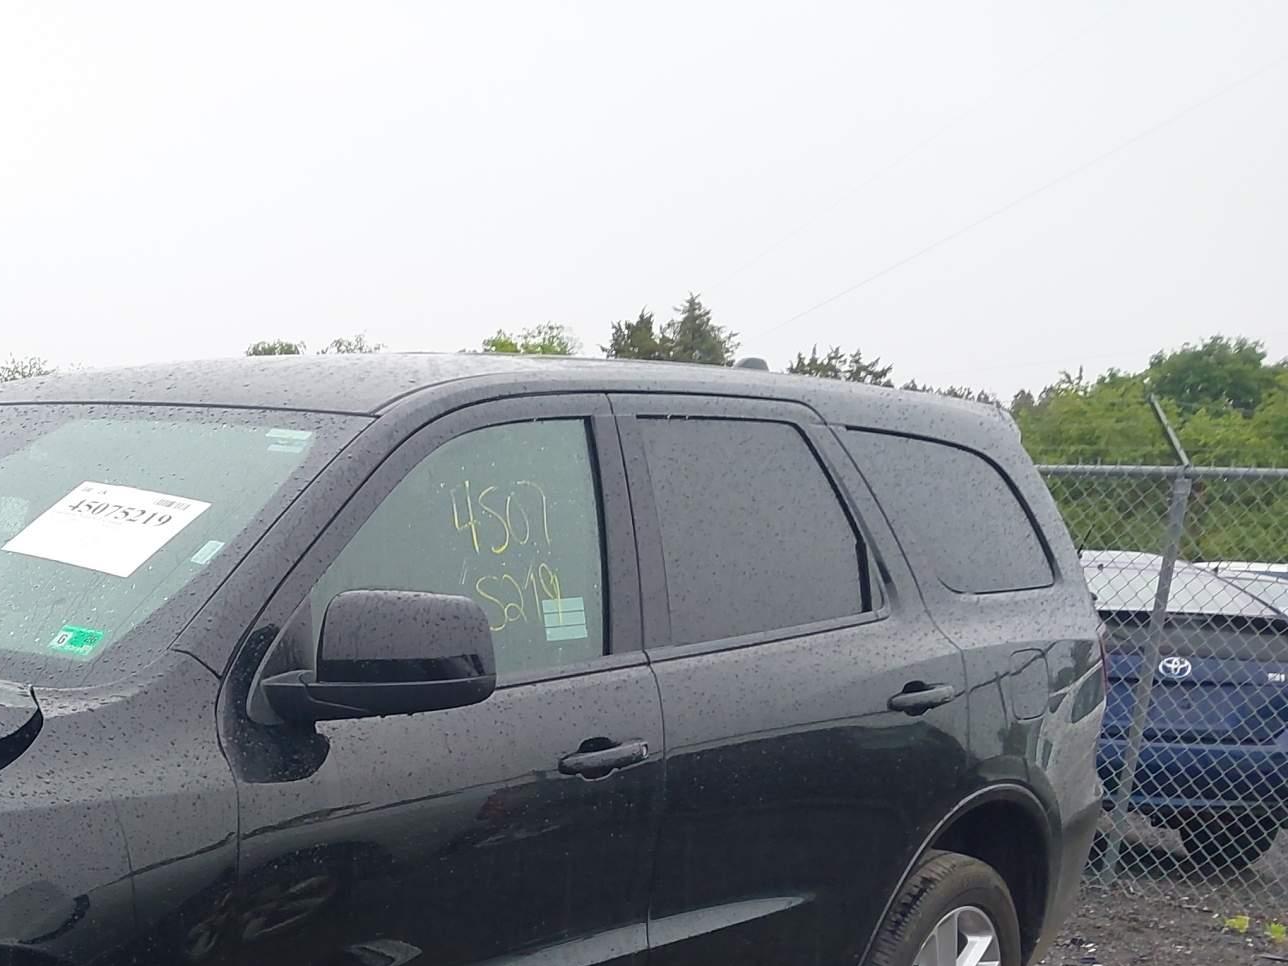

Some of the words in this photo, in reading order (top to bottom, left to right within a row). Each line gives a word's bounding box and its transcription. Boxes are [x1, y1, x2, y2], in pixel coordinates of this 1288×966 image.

[68, 499, 172, 527] 45075219
[450, 480, 551, 553] 4507
[476, 562, 562, 631] 5219
